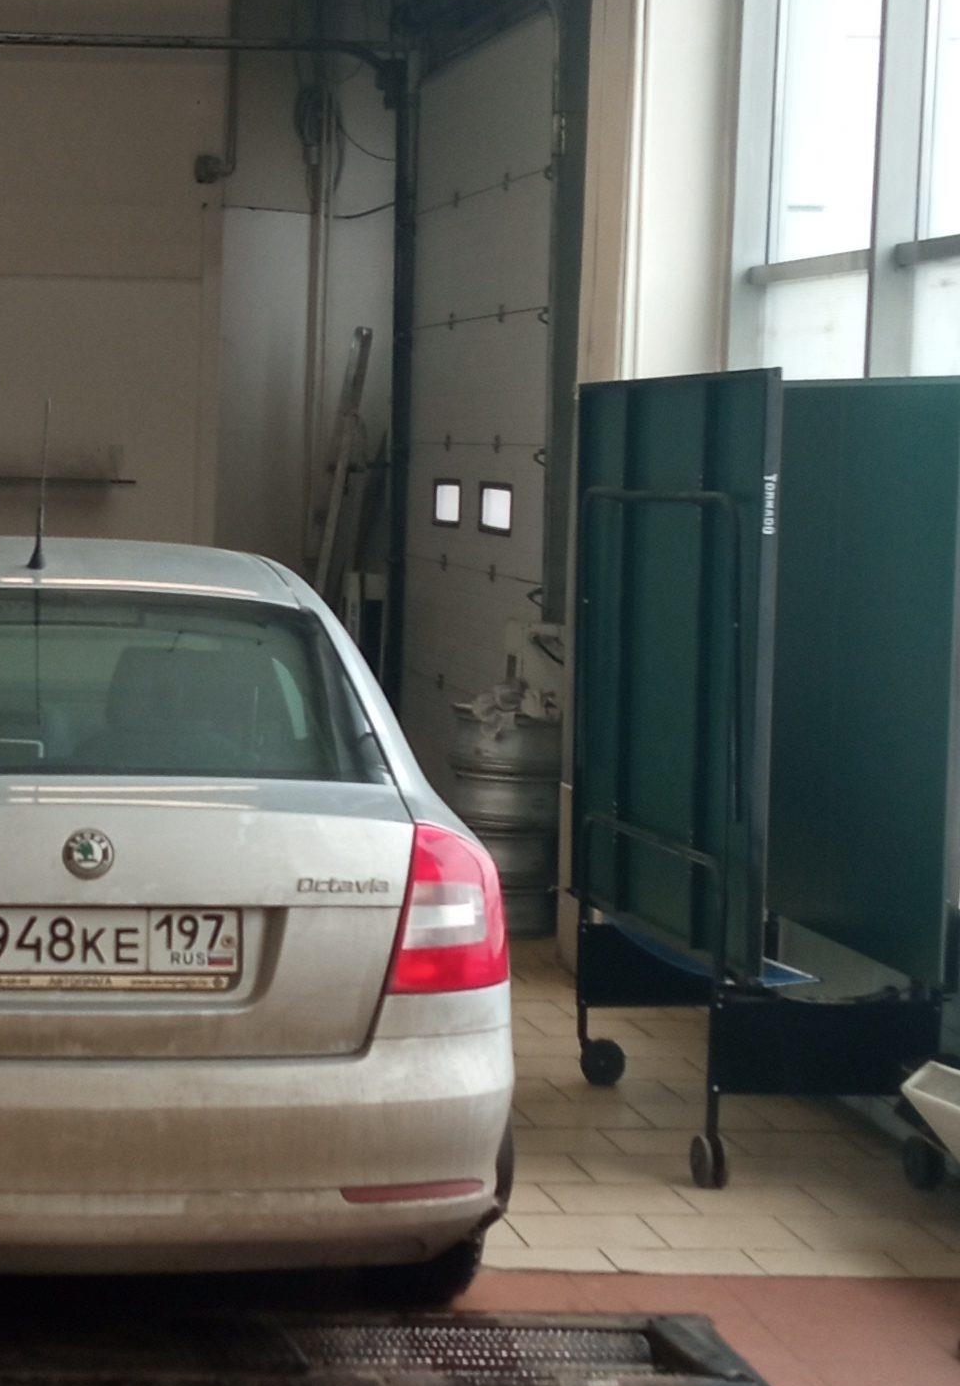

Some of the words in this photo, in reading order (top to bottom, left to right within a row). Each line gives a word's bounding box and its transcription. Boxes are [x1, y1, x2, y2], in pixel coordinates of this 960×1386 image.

[297, 877, 390, 895] Octavia
[154, 914, 225, 951] 197
[169, 951, 207, 966] RUS
